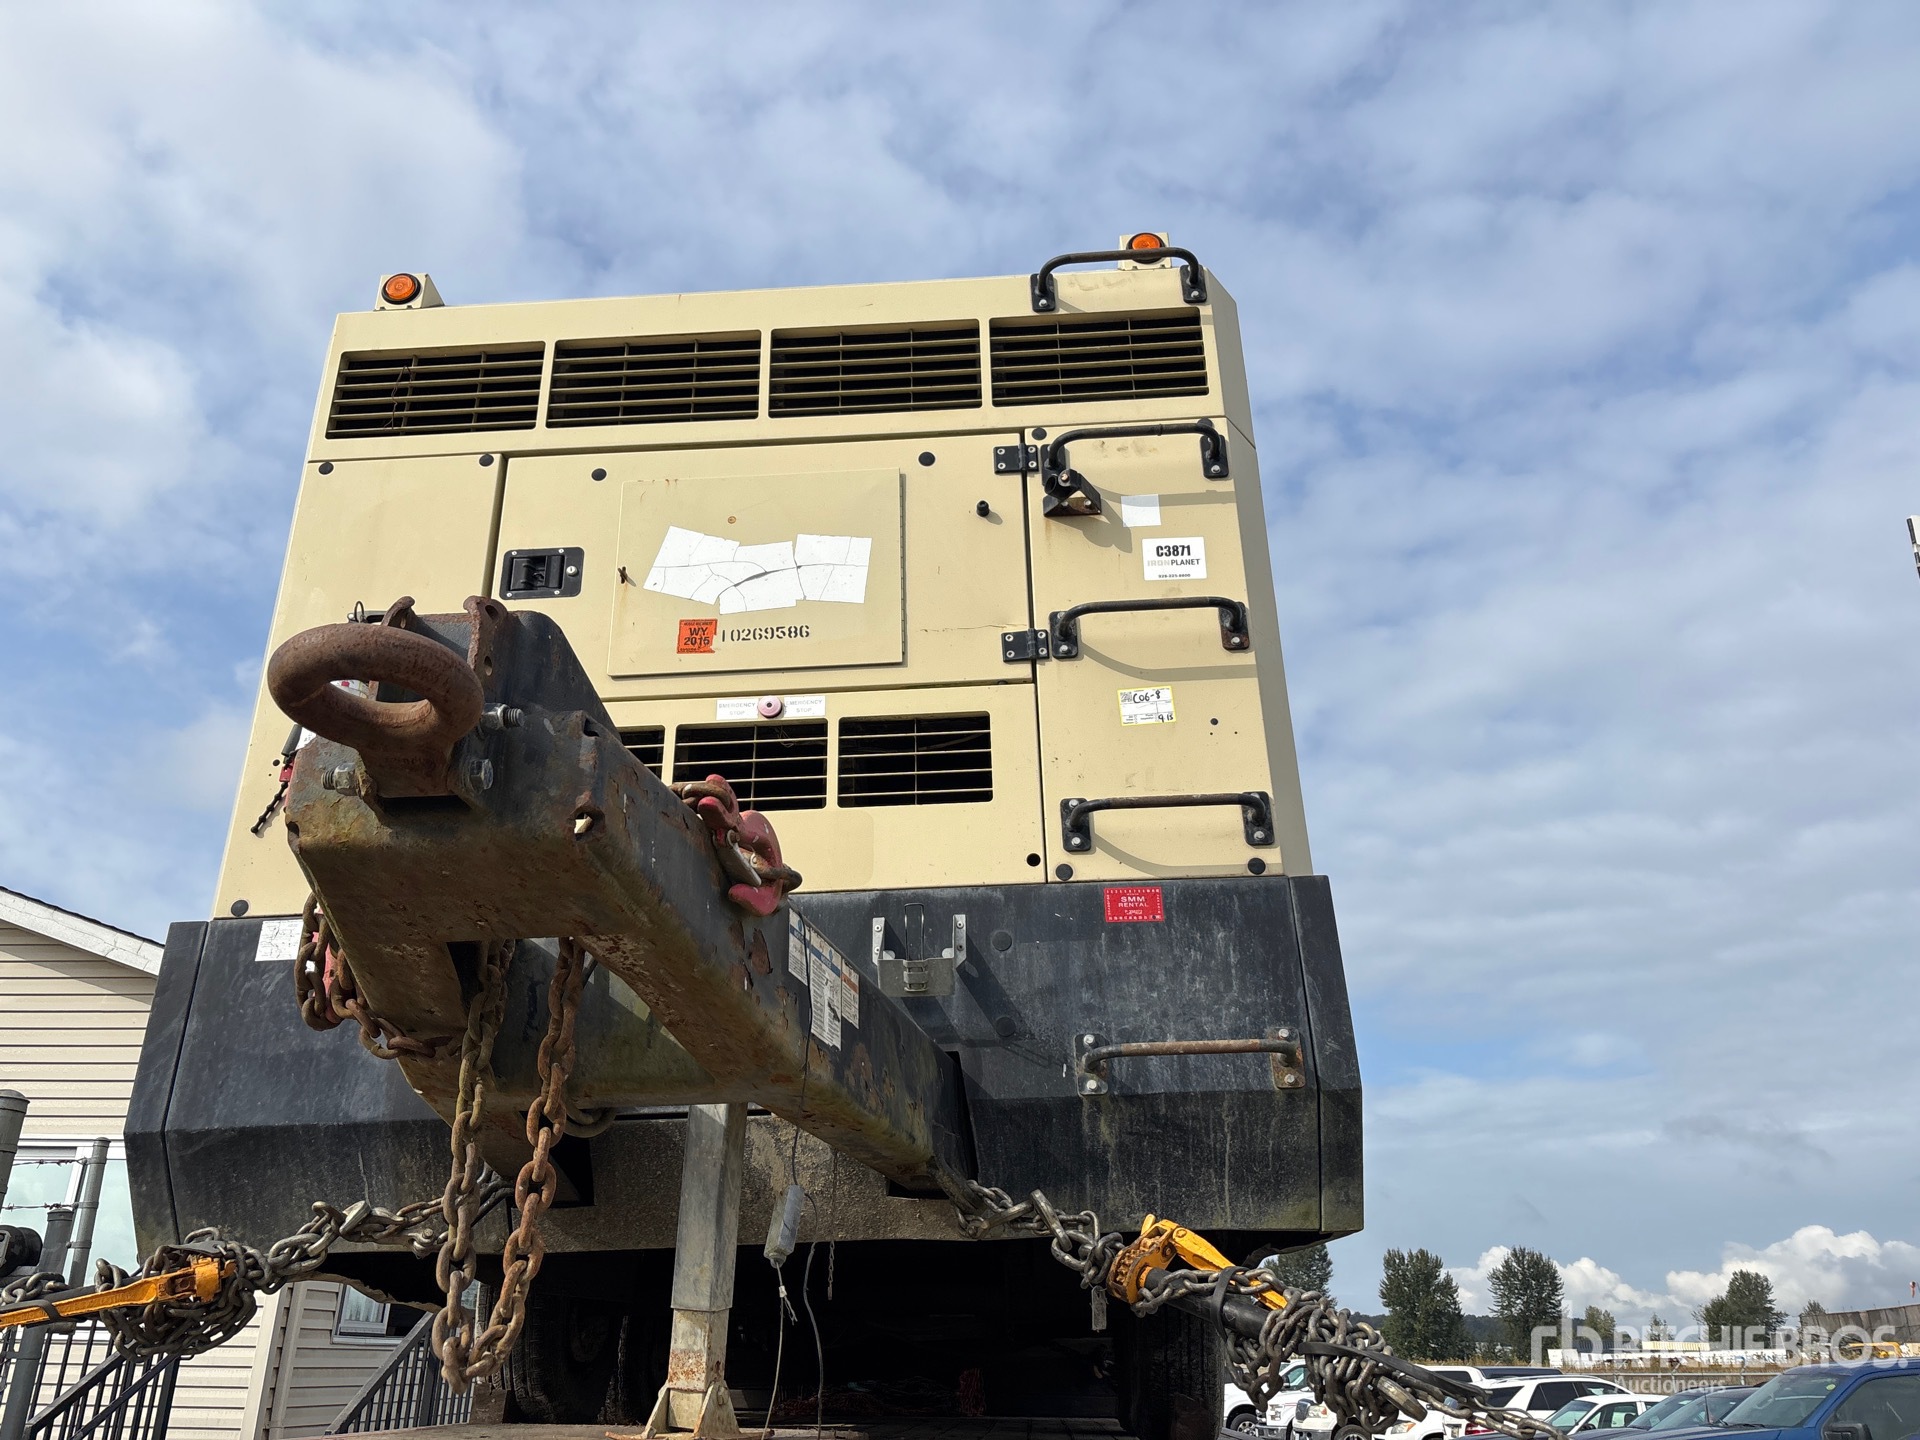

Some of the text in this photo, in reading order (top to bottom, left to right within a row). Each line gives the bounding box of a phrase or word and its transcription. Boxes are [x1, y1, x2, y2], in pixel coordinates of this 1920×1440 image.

[1155, 544, 1191, 557] C3871
[689, 627, 708, 636] WY
[721, 625, 810, 643] 10269586
[683, 636, 710, 646] 2015
